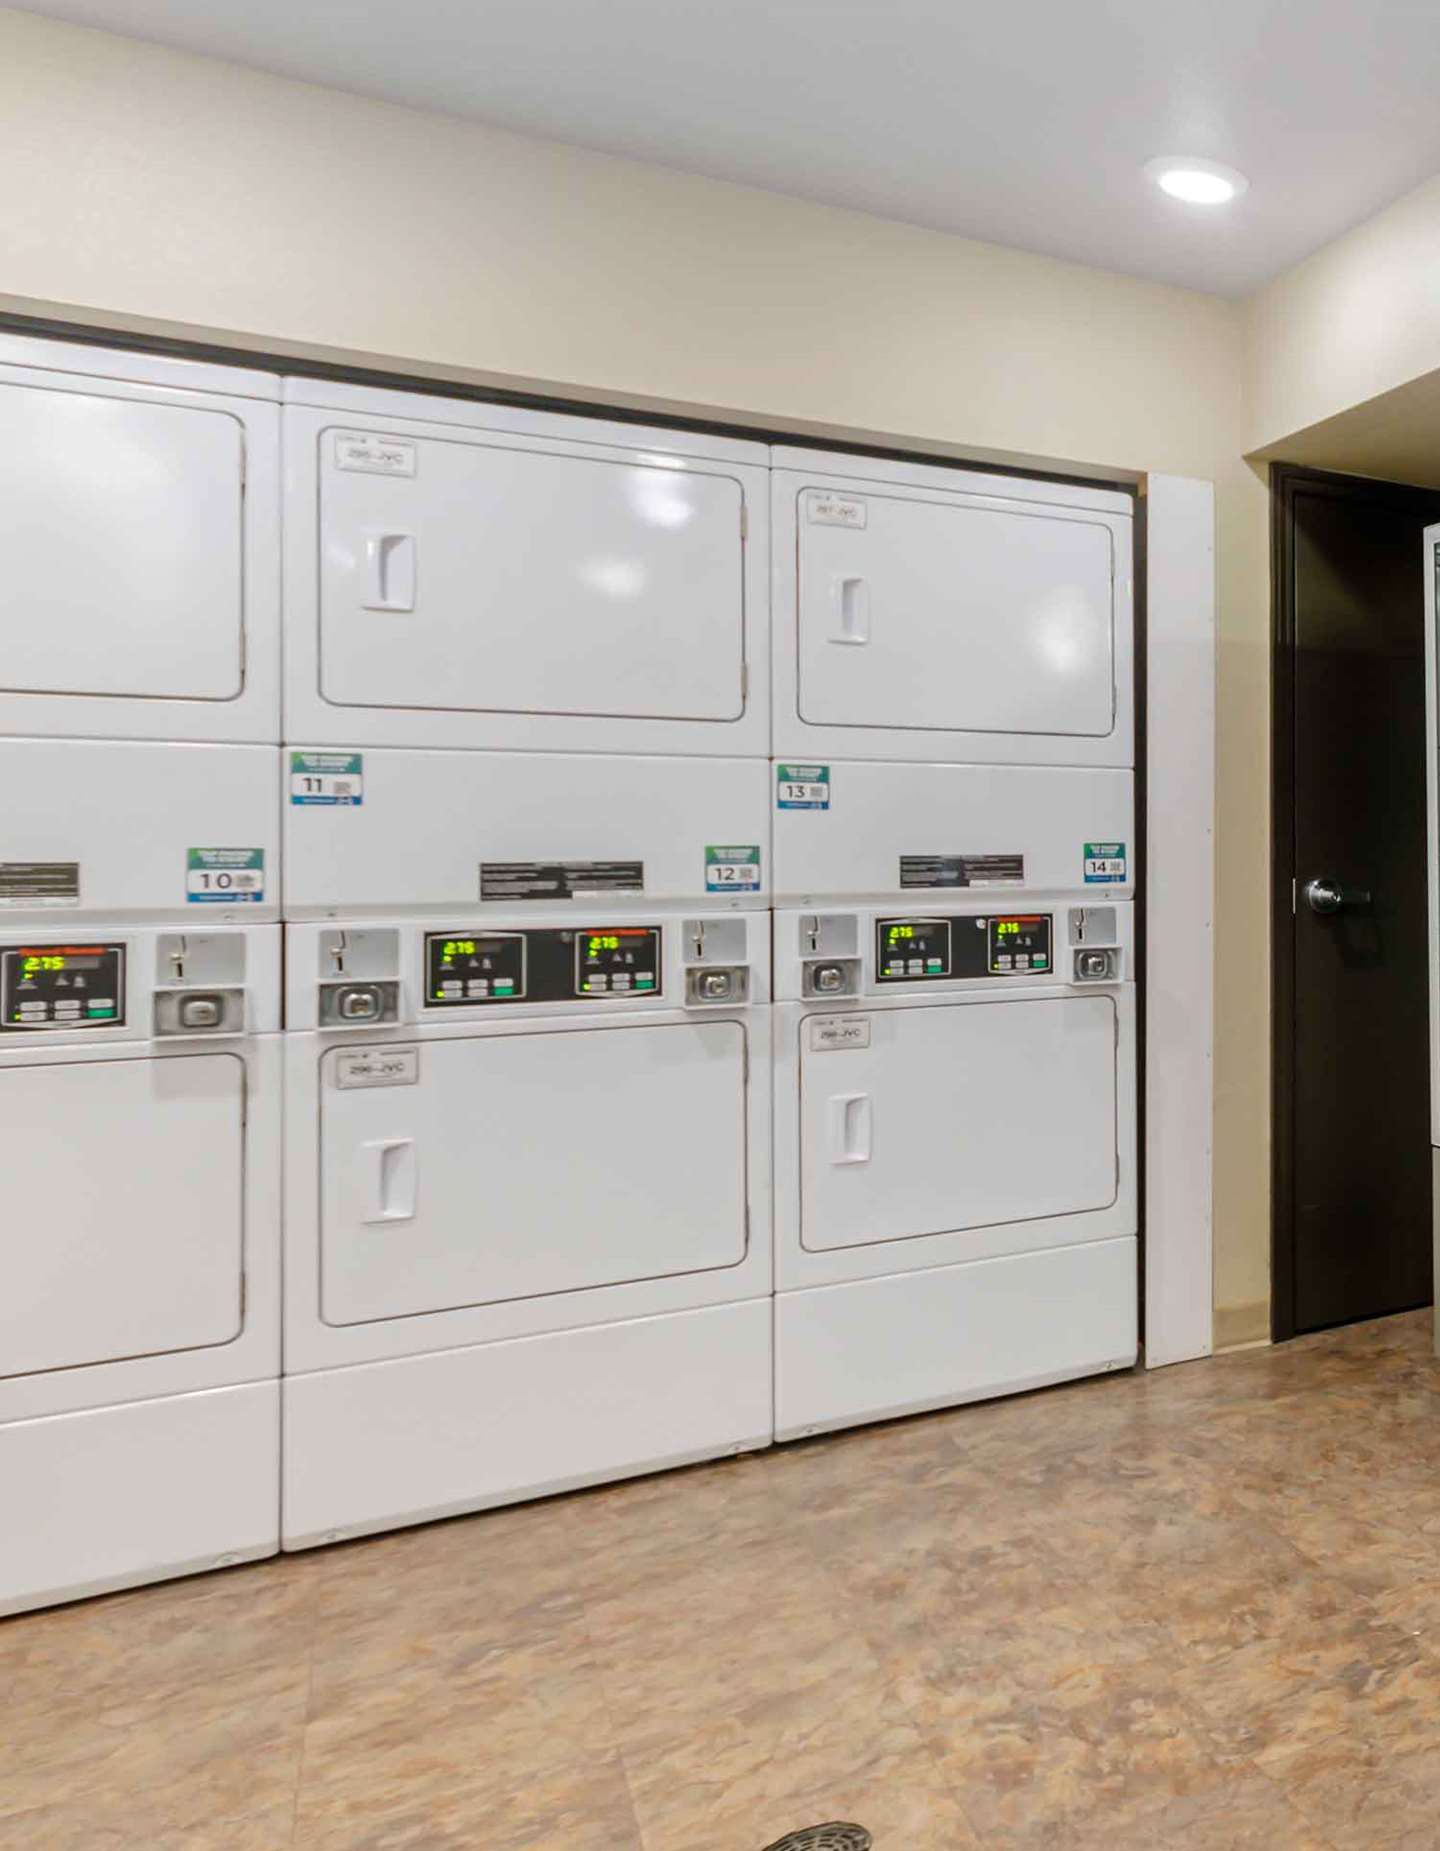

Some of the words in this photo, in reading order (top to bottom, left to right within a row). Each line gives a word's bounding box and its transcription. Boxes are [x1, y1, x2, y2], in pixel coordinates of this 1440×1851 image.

[302, 777, 322, 792] 11
[786, 785, 806, 798] 13
[715, 867, 736, 881] 12
[1091, 861, 1107, 873] 14
[200, 873, 233, 889] 10
